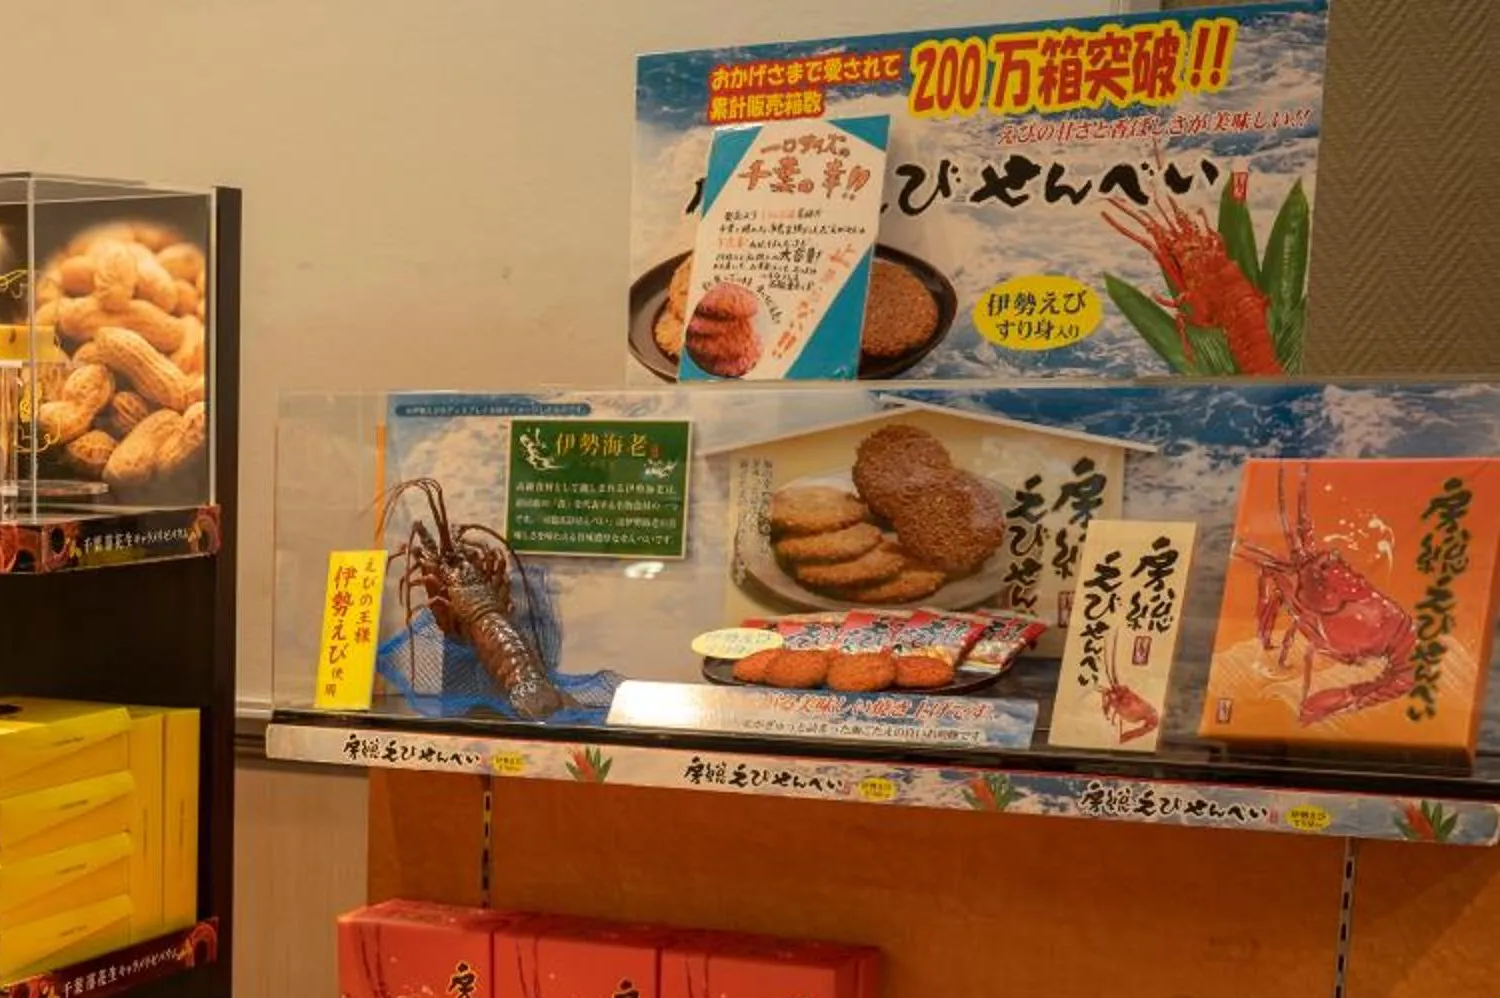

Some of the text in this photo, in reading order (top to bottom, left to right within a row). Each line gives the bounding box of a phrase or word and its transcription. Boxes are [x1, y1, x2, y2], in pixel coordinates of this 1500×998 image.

[710, 52, 901, 92] おかげさまで愛されて
[708, 91, 824, 122] 累計販売箱数
[987, 290, 1088, 321] 伊勢えび
[993, 318, 1081, 344] すり身入り
[556, 432, 648, 457] 伊勢海老
